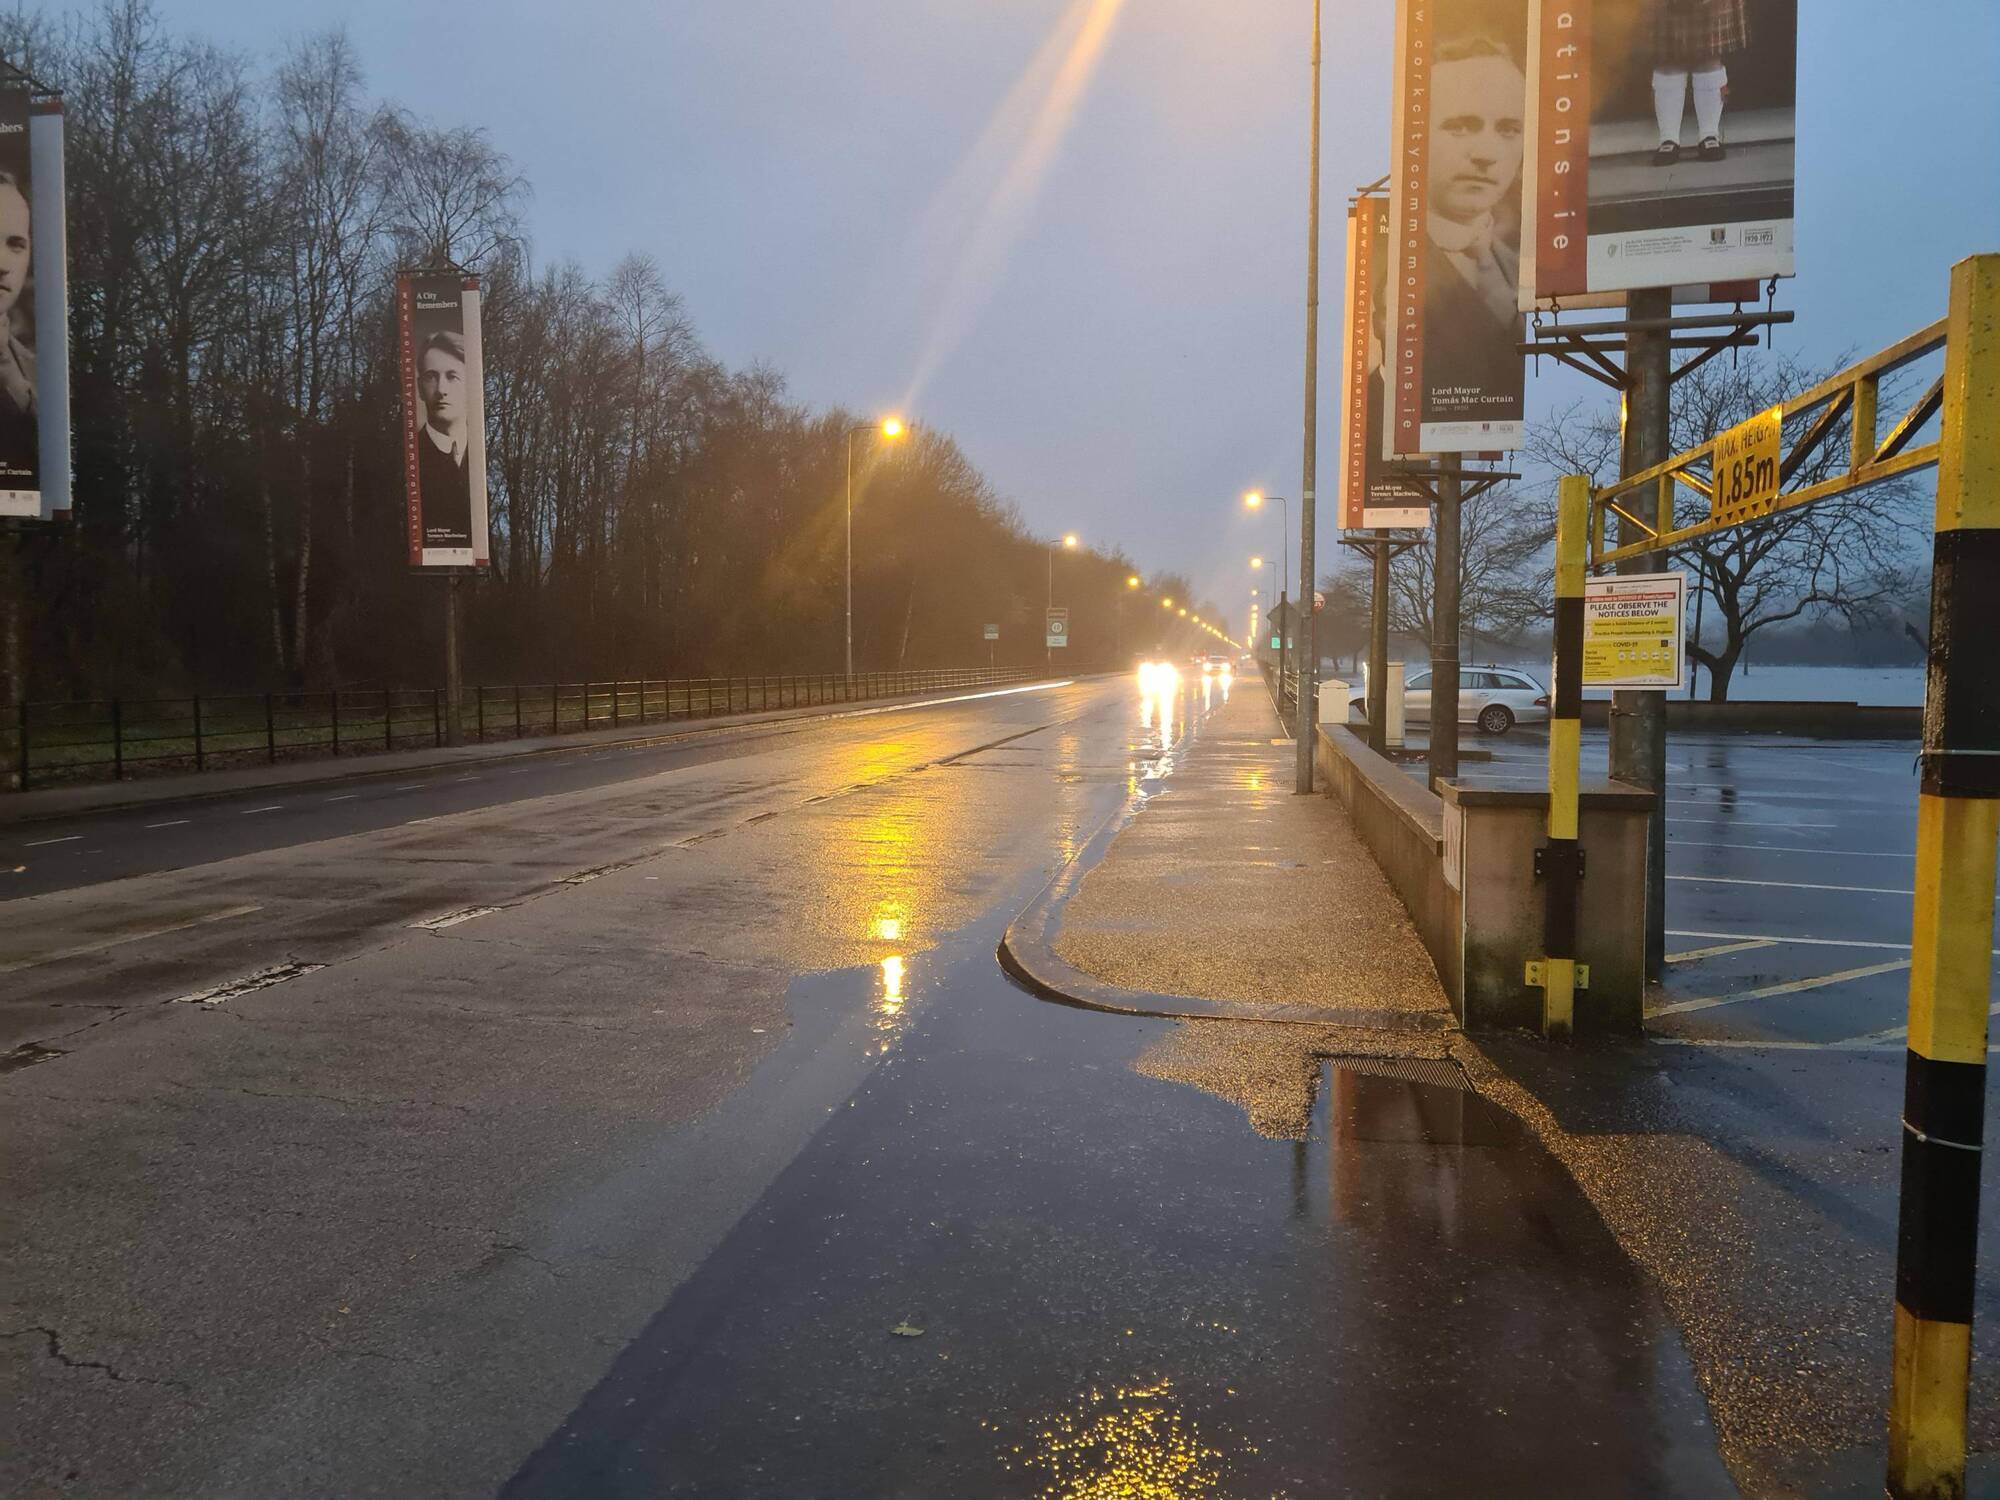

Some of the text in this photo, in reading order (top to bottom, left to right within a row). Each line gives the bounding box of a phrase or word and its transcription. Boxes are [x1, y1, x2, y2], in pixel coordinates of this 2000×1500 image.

[0, 122, 24, 133] bers
[1403, 0, 1425, 429] w.corkcitycommemorations.ie
[423, 292, 437, 300] City
[416, 301, 458, 310] Remembers
[1352, 213, 1368, 512] www.corkcitycommemorations.ie
[1432, 387, 1480, 396] Lord Mayor
[1432, 396, 1460, 404] Tomás
[1480, 395, 1514, 403] Curtain
[402, 292, 419, 551] www.corkcitycommemorations.ie
[1717, 454, 1774, 508] 1.85m
[1618, 602, 1652, 610] OBSERVE
